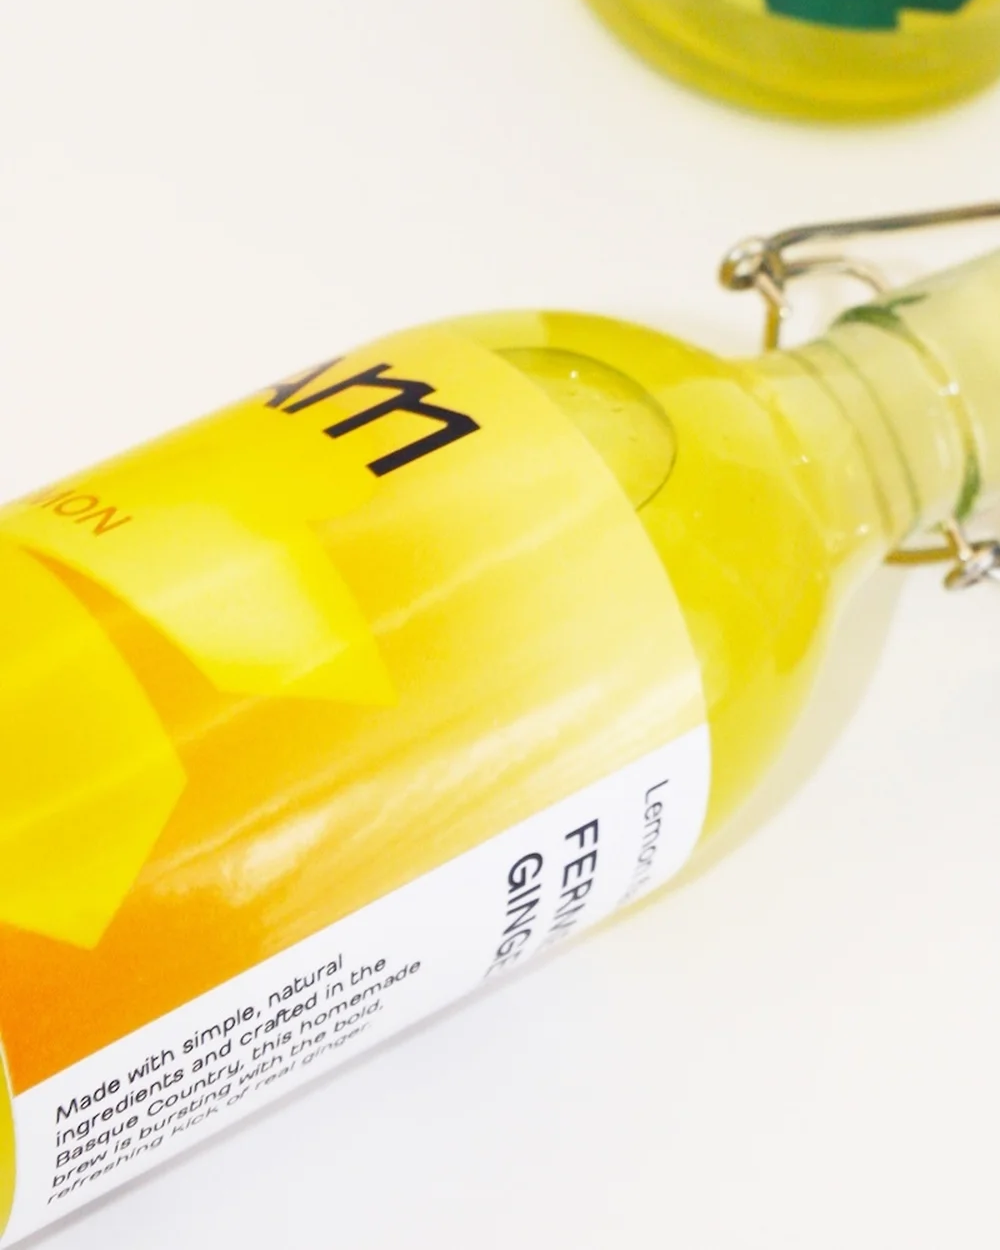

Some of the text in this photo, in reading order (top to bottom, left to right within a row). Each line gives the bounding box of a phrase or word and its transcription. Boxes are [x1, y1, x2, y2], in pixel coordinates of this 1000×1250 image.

[47, 1136, 164, 1205] refreshing
[171, 1105, 219, 1138] kick
[226, 1086, 251, 1107] of
[254, 1061, 296, 1092] real
[52, 999, 384, 1188] brew is bursting with the bold,
[55, 953, 343, 1124] Made with simple, natural
[55, 961, 421, 1169] Basque Country, this homemade
[56, 958, 386, 1147] ingredients and crafted in the
